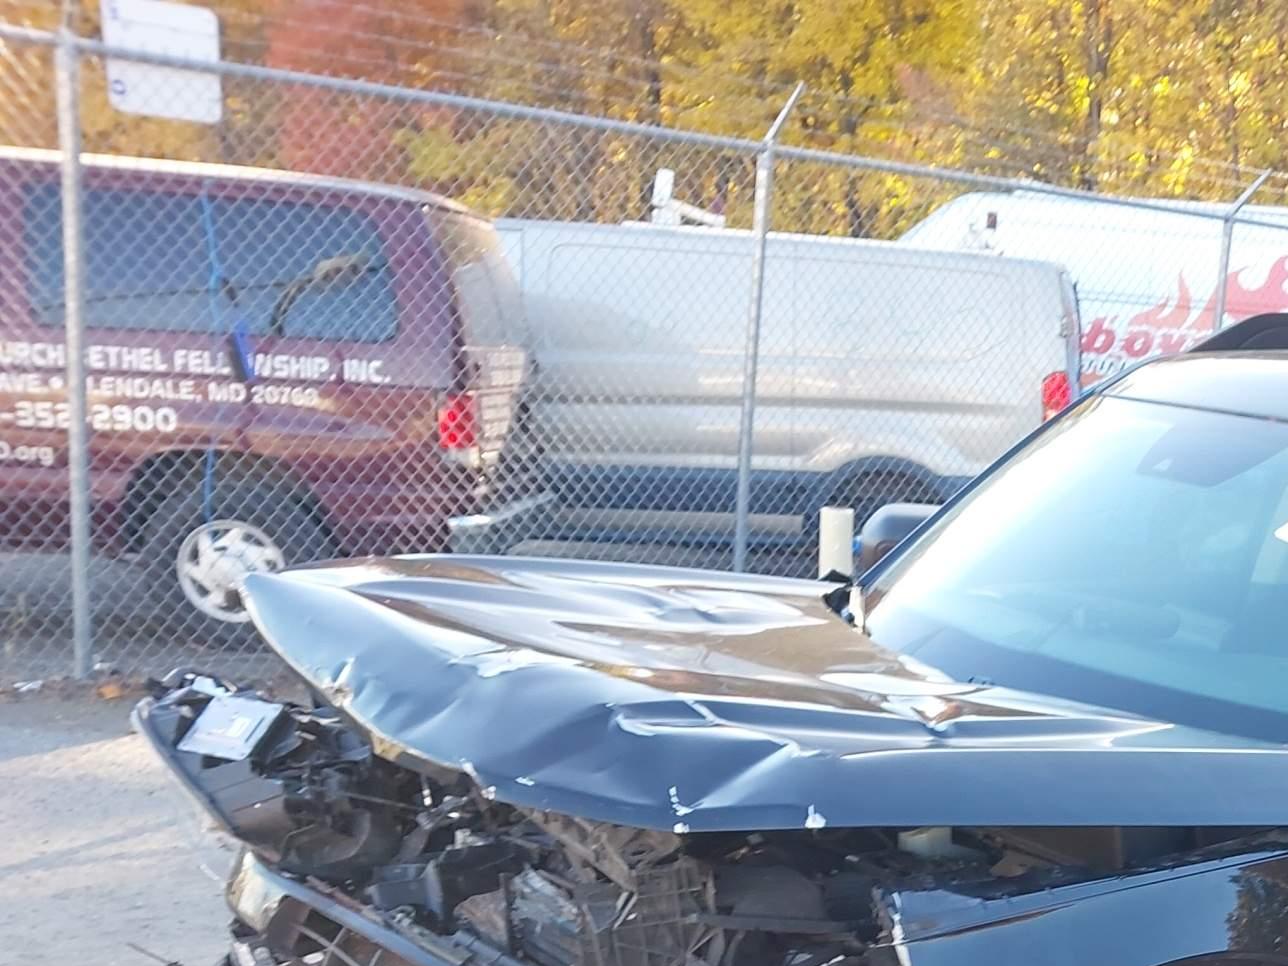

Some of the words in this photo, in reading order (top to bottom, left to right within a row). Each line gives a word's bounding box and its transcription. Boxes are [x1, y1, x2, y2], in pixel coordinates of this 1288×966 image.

[82, 345, 168, 371] ETHEL
[173, 349, 337, 381] FELLWSHIP,
[343, 358, 392, 383] INC.
[84, 376, 202, 403] LENDALE,
[207, 382, 247, 403] MD
